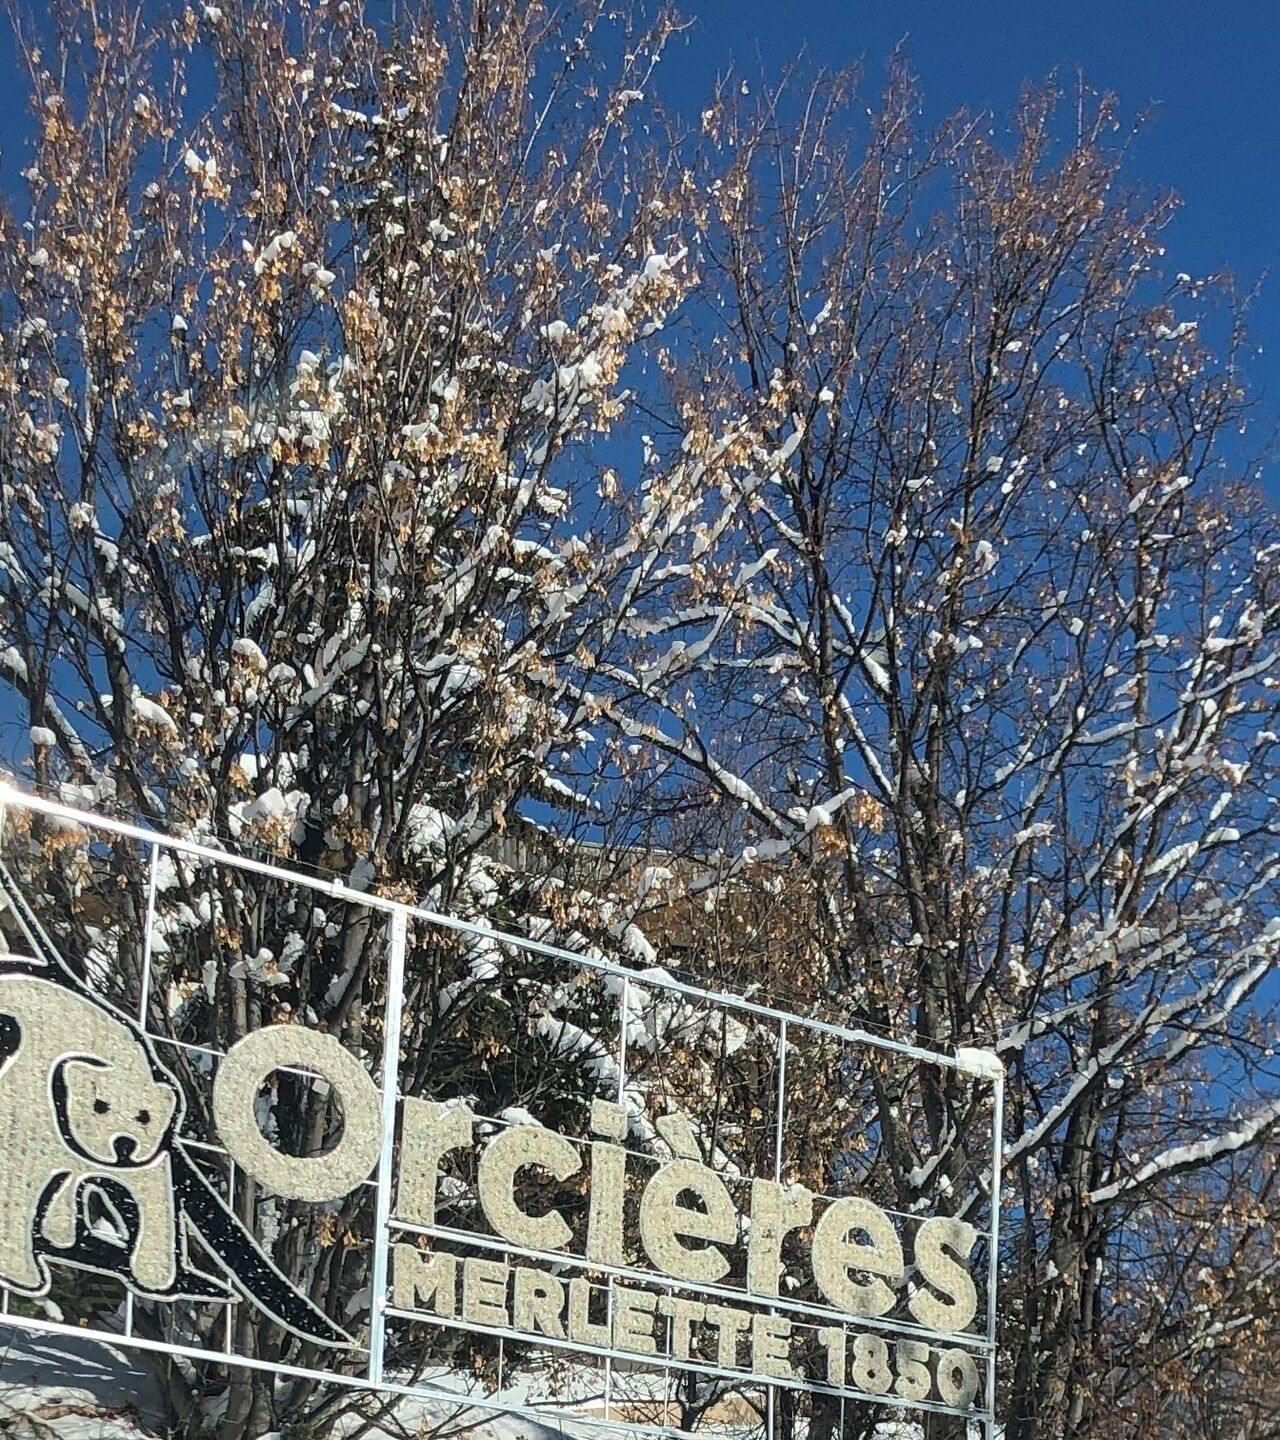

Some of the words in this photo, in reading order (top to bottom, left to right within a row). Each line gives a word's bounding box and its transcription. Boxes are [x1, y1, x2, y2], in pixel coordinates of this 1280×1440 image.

[212, 1024, 979, 1333] Orcières
[392, 1241, 793, 1379] MERLETTE
[818, 1325, 980, 1411] 1850
